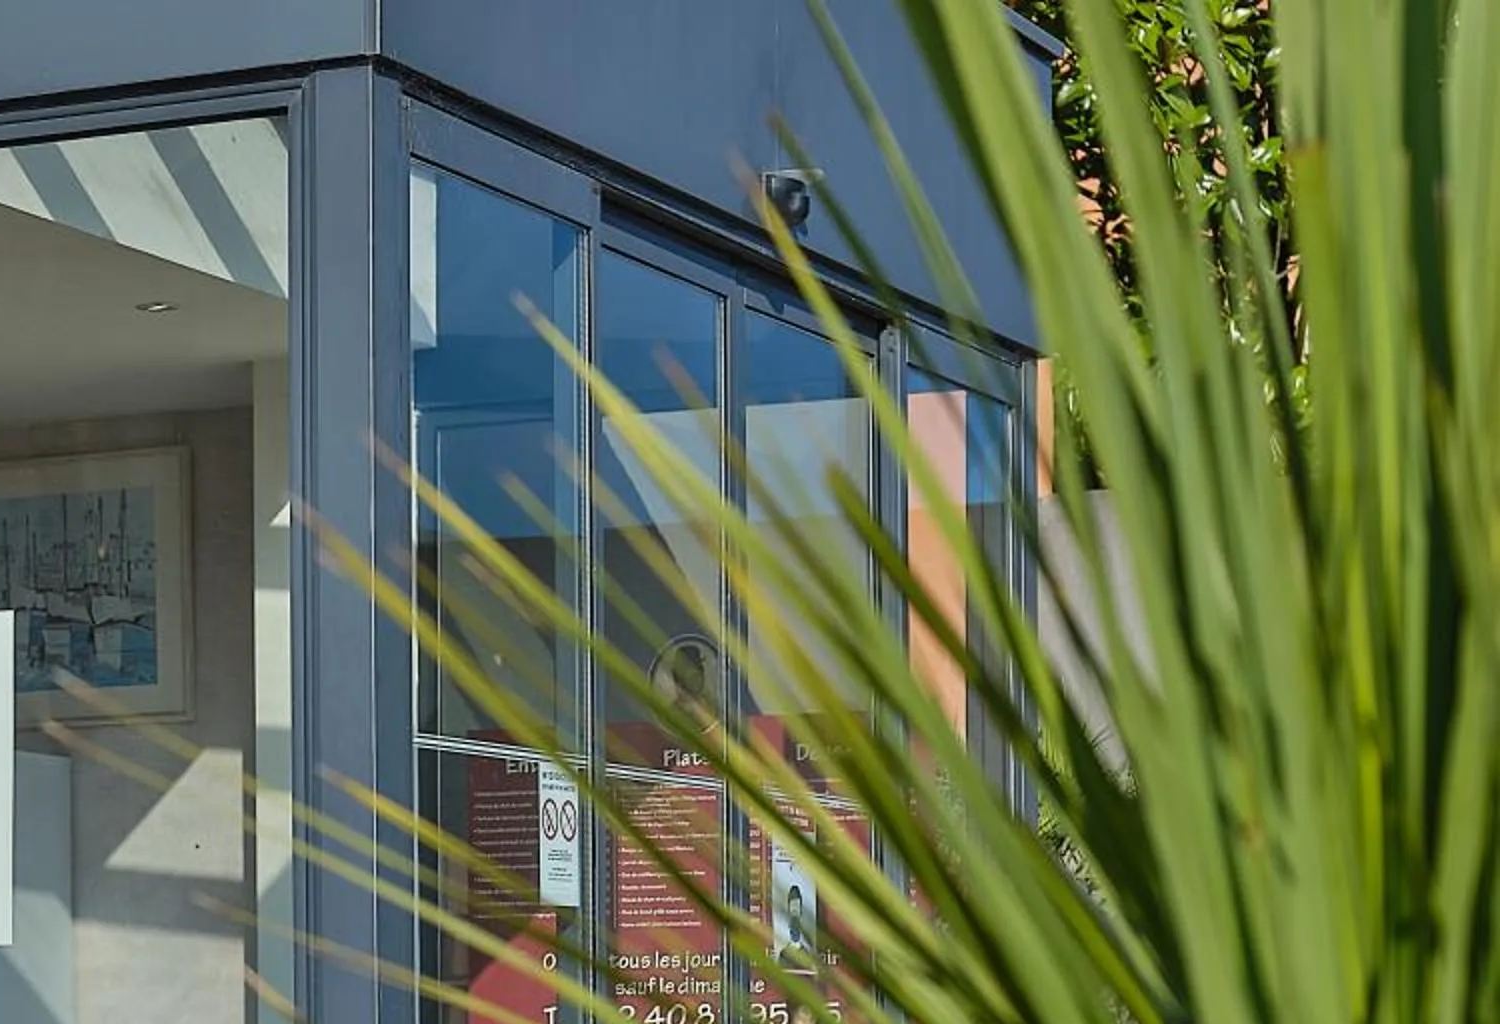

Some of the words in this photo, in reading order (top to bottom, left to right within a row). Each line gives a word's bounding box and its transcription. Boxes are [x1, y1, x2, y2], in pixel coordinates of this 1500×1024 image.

[609, 953, 651, 969] tous
[655, 949, 681, 969] les
[681, 950, 721, 973] jour
[615, 977, 657, 995] sauf
[659, 977, 676, 993] le
